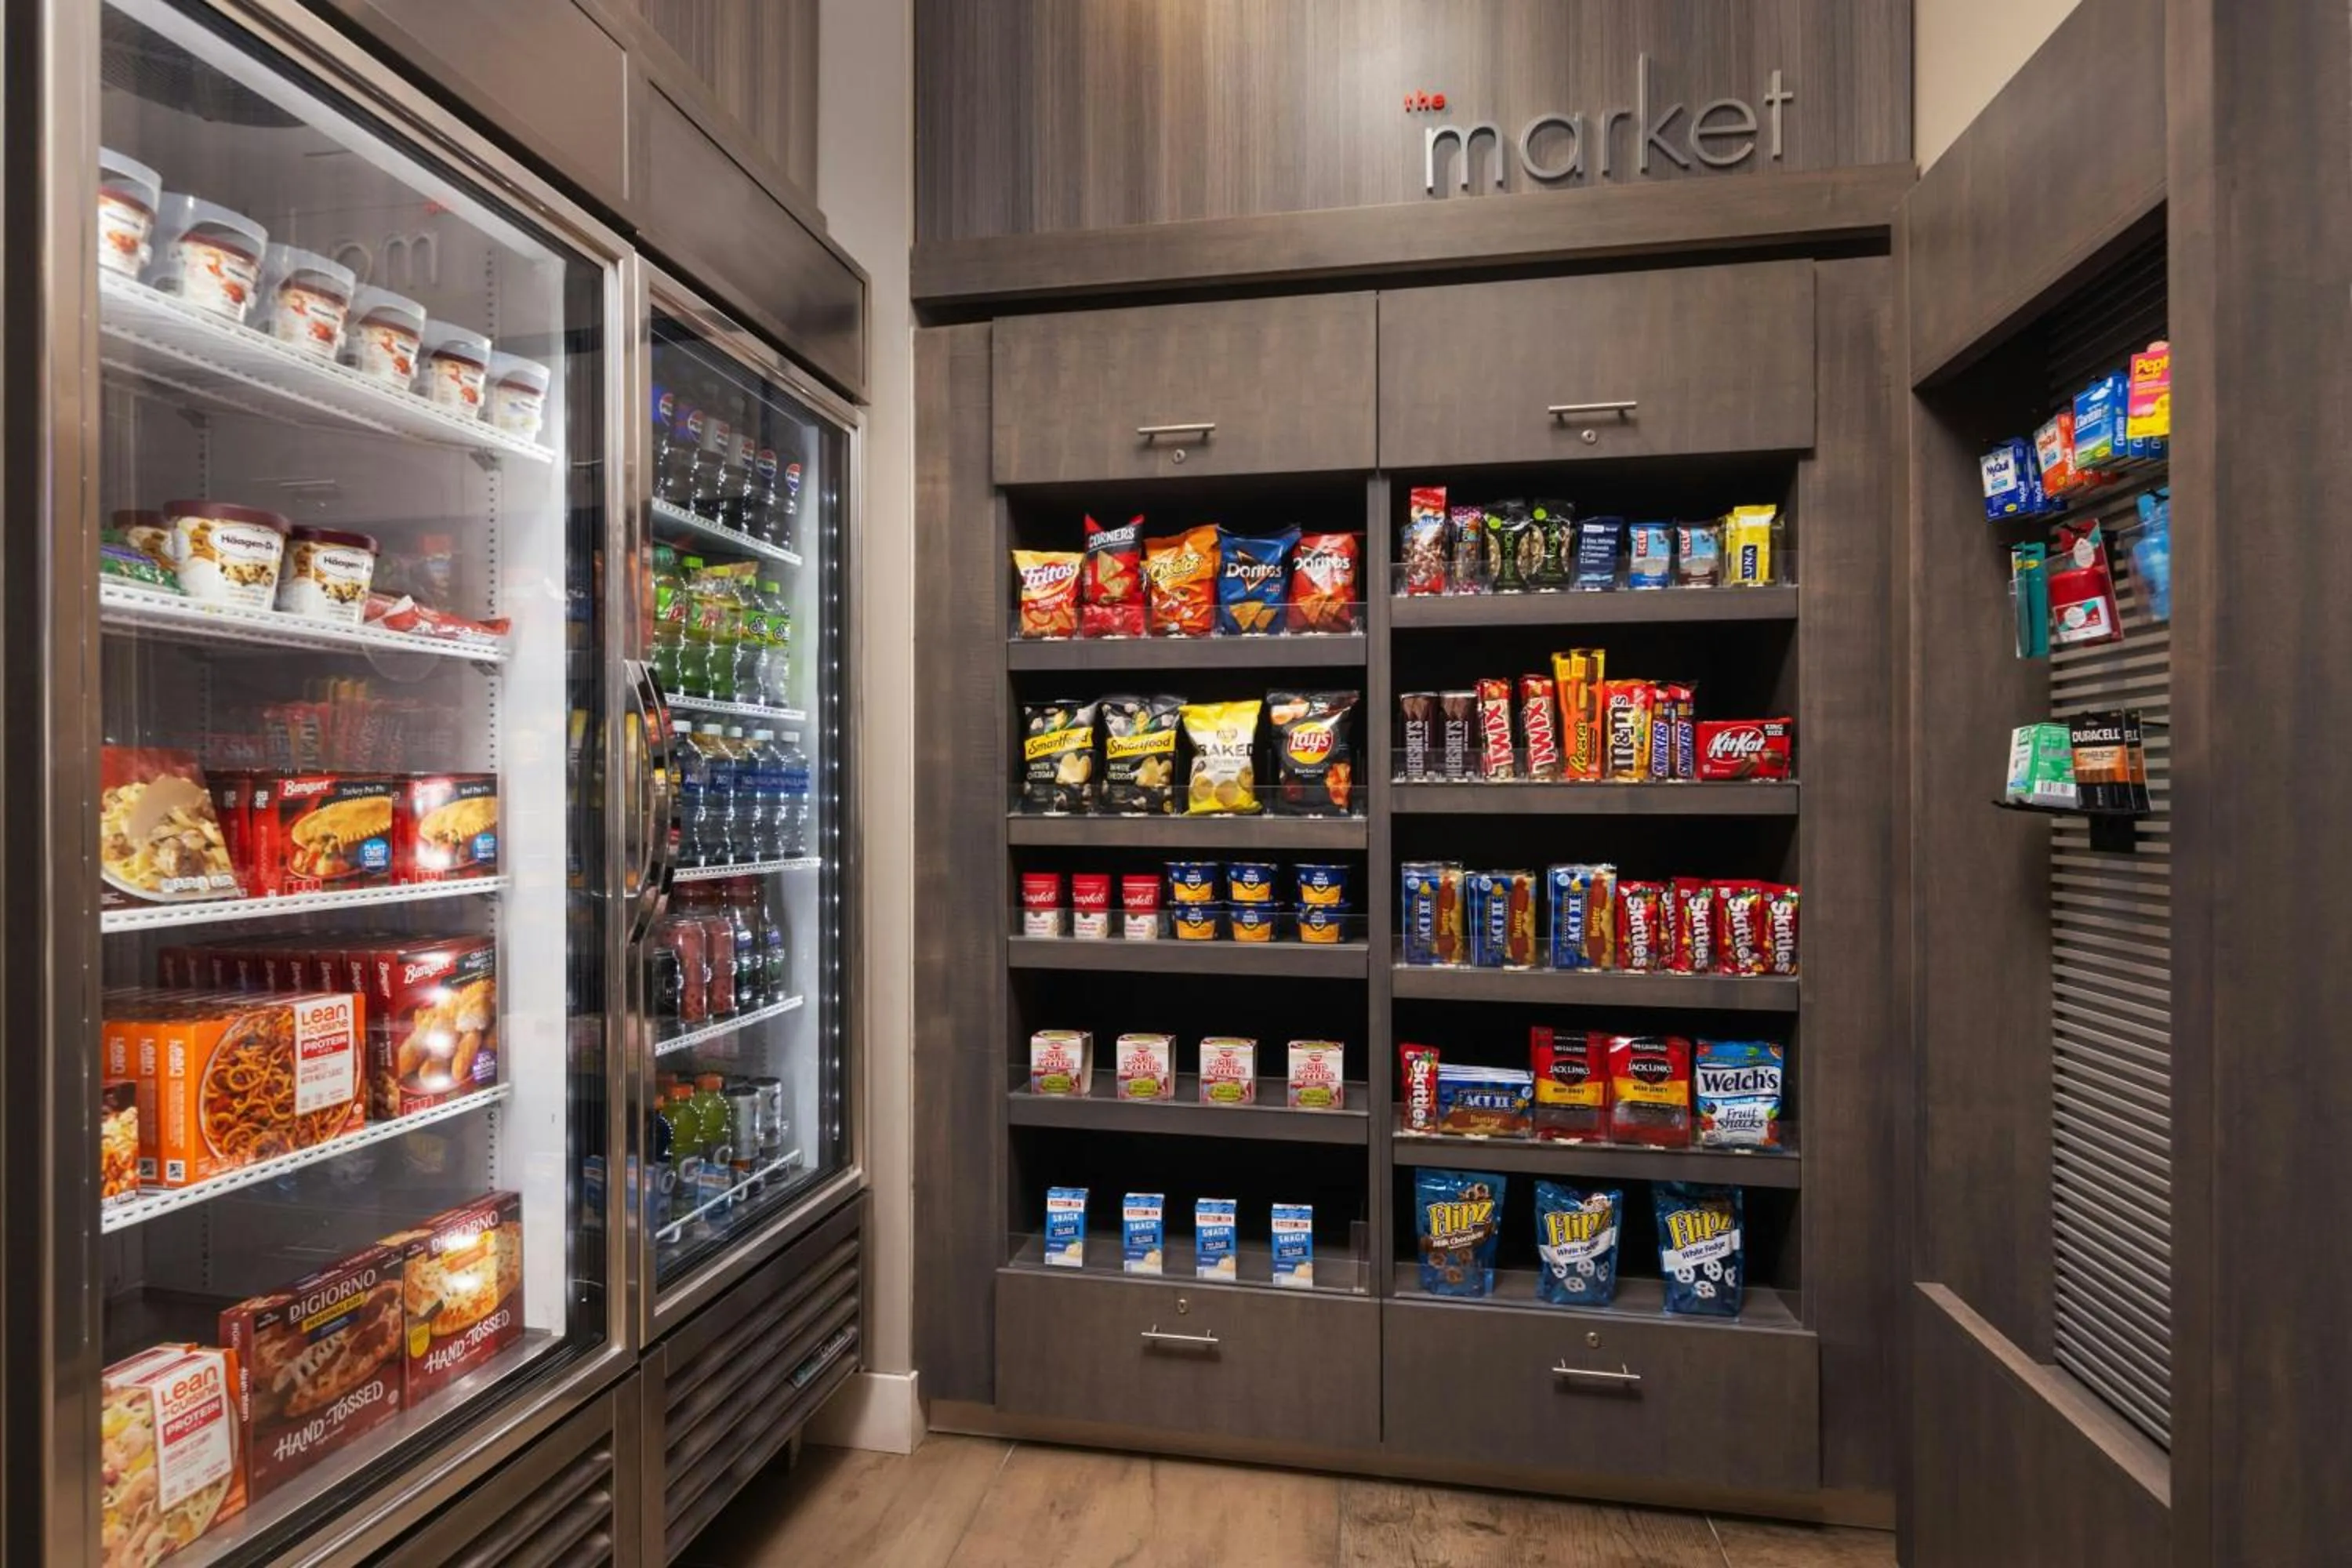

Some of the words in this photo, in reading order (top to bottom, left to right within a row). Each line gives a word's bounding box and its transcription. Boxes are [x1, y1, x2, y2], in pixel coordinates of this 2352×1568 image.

[1425, 53, 1794, 194] market
[1088, 526, 1136, 548] CORNERS
[1225, 562, 1283, 578] Doritos
[1294, 553, 1351, 571] Doritos
[1020, 562, 1074, 588] Fritos
[1028, 733, 1088, 755] Smartfood
[1107, 737, 1171, 755] Smartfood
[1485, 703, 1513, 774] TWIX
[1528, 702, 1556, 773] TWIX
[2071, 728, 2122, 743] DURACELL
[1626, 896, 1649, 967] Skittles
[1688, 897, 1710, 969] Skittles
[1728, 898, 1753, 968] Skittles
[1770, 900, 1795, 974] Skittles
[301, 1003, 348, 1025] Lean
[303, 1034, 347, 1052] PROTEIN
[1701, 1068, 1779, 1093] Welch's
[1410, 1058, 1431, 1129] Skittles
[1465, 1094, 1490, 1109] ACT
[1493, 1095, 1509, 1109] II
[1717, 1117, 1765, 1130] Snacks
[1726, 1107, 1758, 1120] Fruit
[1202, 1227, 1230, 1237] SNACK
[1278, 1233, 1306, 1243] SNACK
[424, 1308, 510, 1374] HAND-TOSSED
[161, 1366, 218, 1406] Lean
[166, 1399, 220, 1436] PROTEIN
[273, 1380, 383, 1462] HAND-TOSSED
